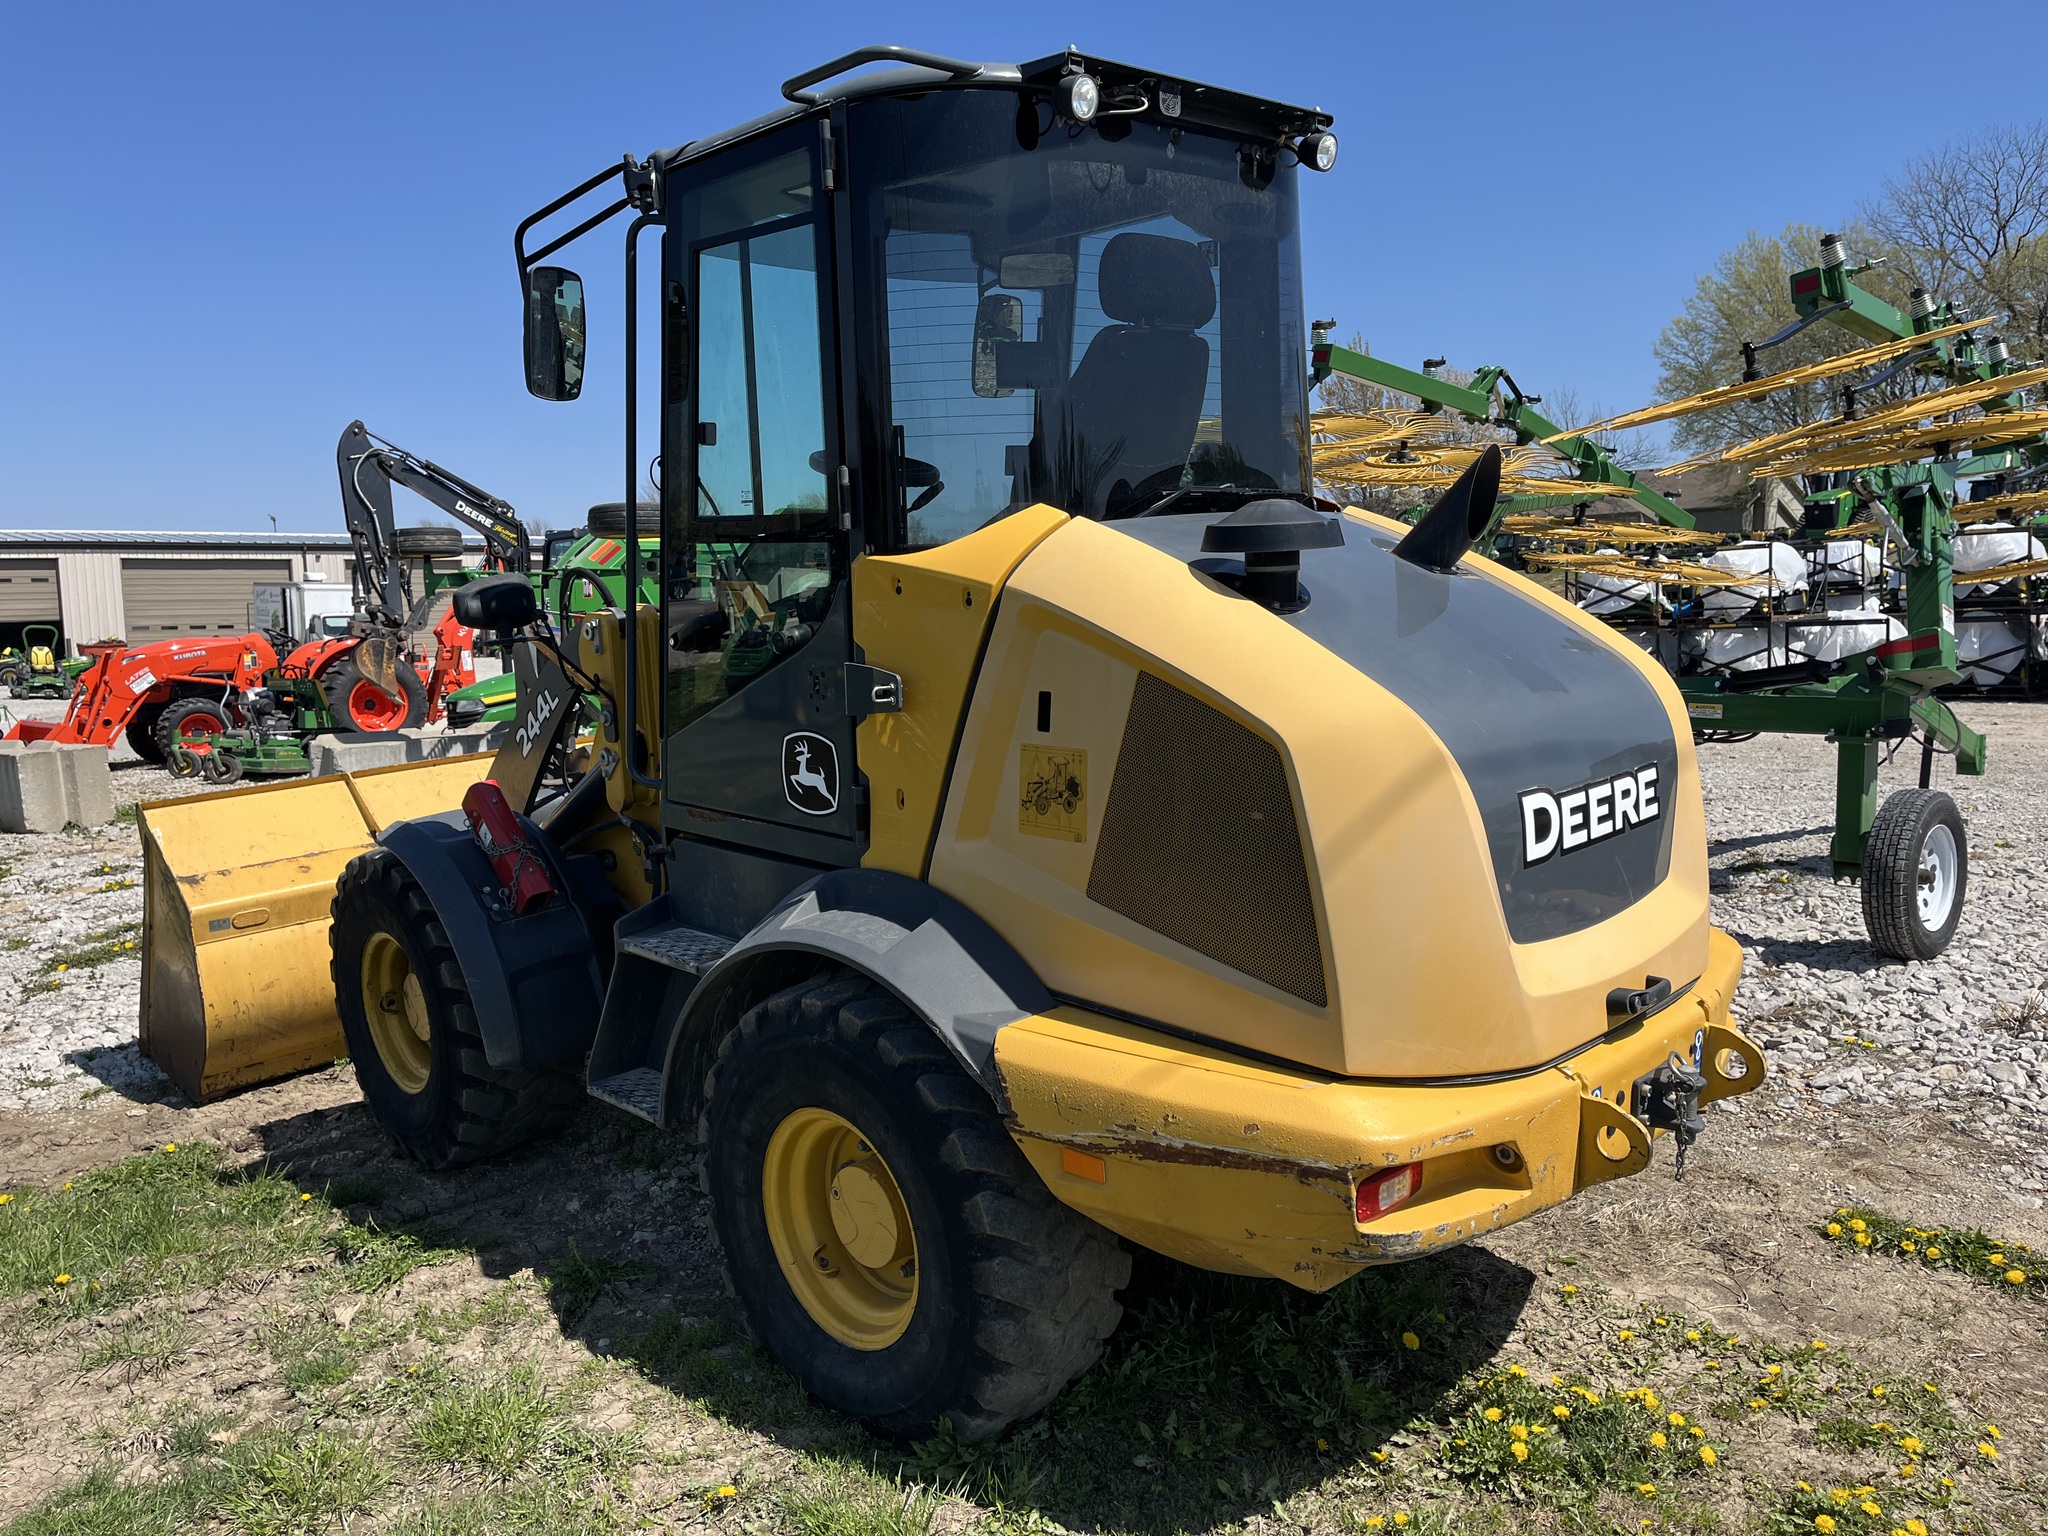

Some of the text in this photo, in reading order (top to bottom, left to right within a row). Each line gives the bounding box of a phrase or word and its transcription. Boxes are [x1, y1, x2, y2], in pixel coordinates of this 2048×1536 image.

[455, 500, 493, 528] DEERE
[173, 650, 207, 661] KUBOTA
[515, 689, 559, 758] 244L
[1521, 766, 1660, 863] DEERE
